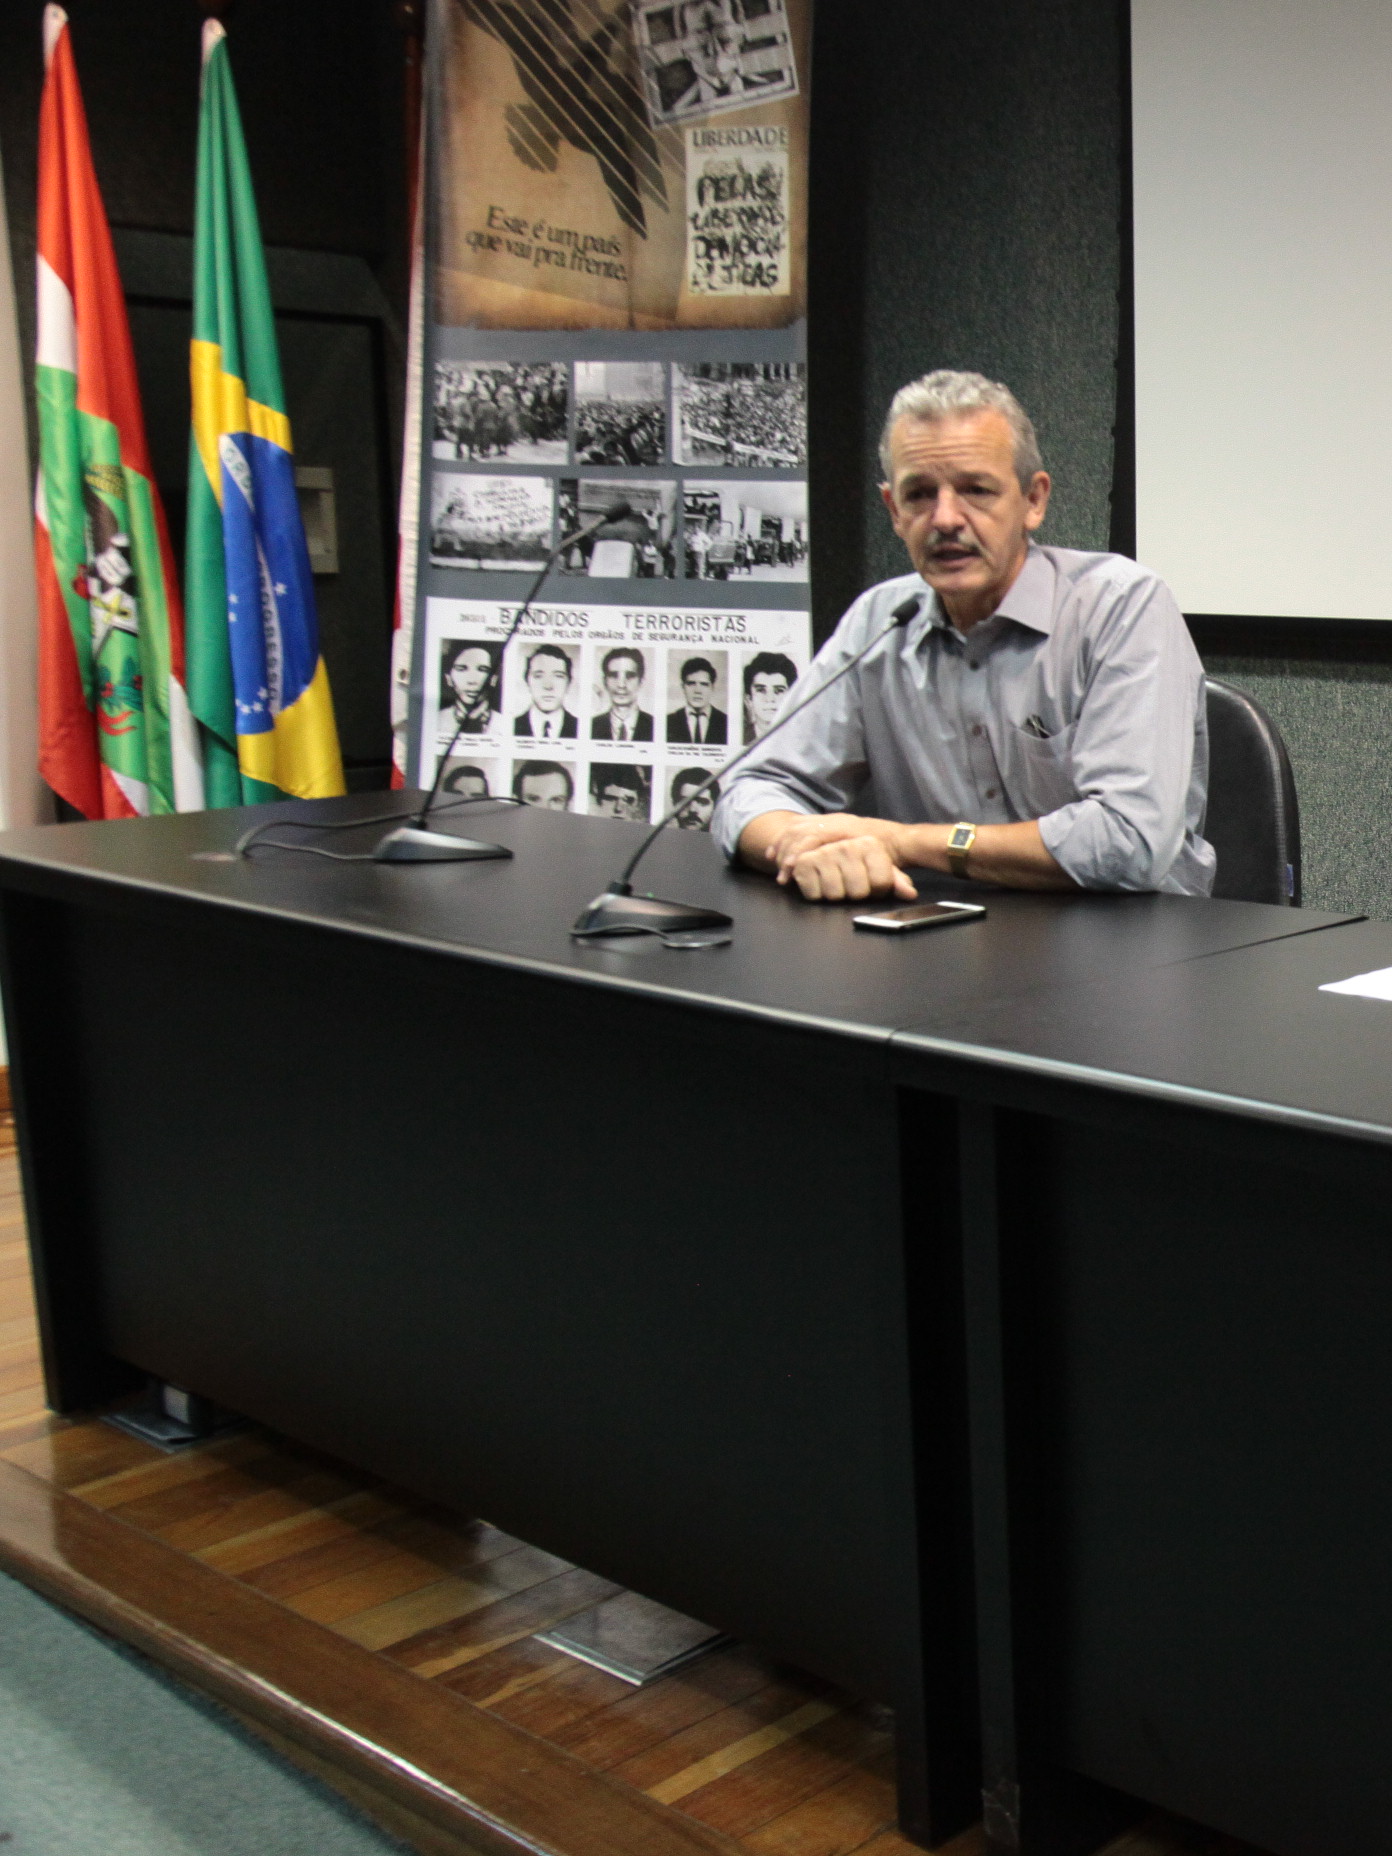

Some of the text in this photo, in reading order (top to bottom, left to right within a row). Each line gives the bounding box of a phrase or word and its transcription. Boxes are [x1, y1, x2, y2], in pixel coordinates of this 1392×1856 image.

[693, 127, 789, 147] LIBERDADE
[486, 204, 622, 258] Este é um país
[465, 231, 502, 253] que
[504, 237, 532, 260] vai
[532, 245, 567, 268] pra
[622, 613, 747, 633] TERRORISTAS
[485, 626, 545, 637] PROCRADOS
[552, 630, 584, 639] PELOS
[632, 632, 644, 641] DE
[649, 632, 704, 644] SEGURANÇA
[711, 635, 760, 645] NACIONAL
